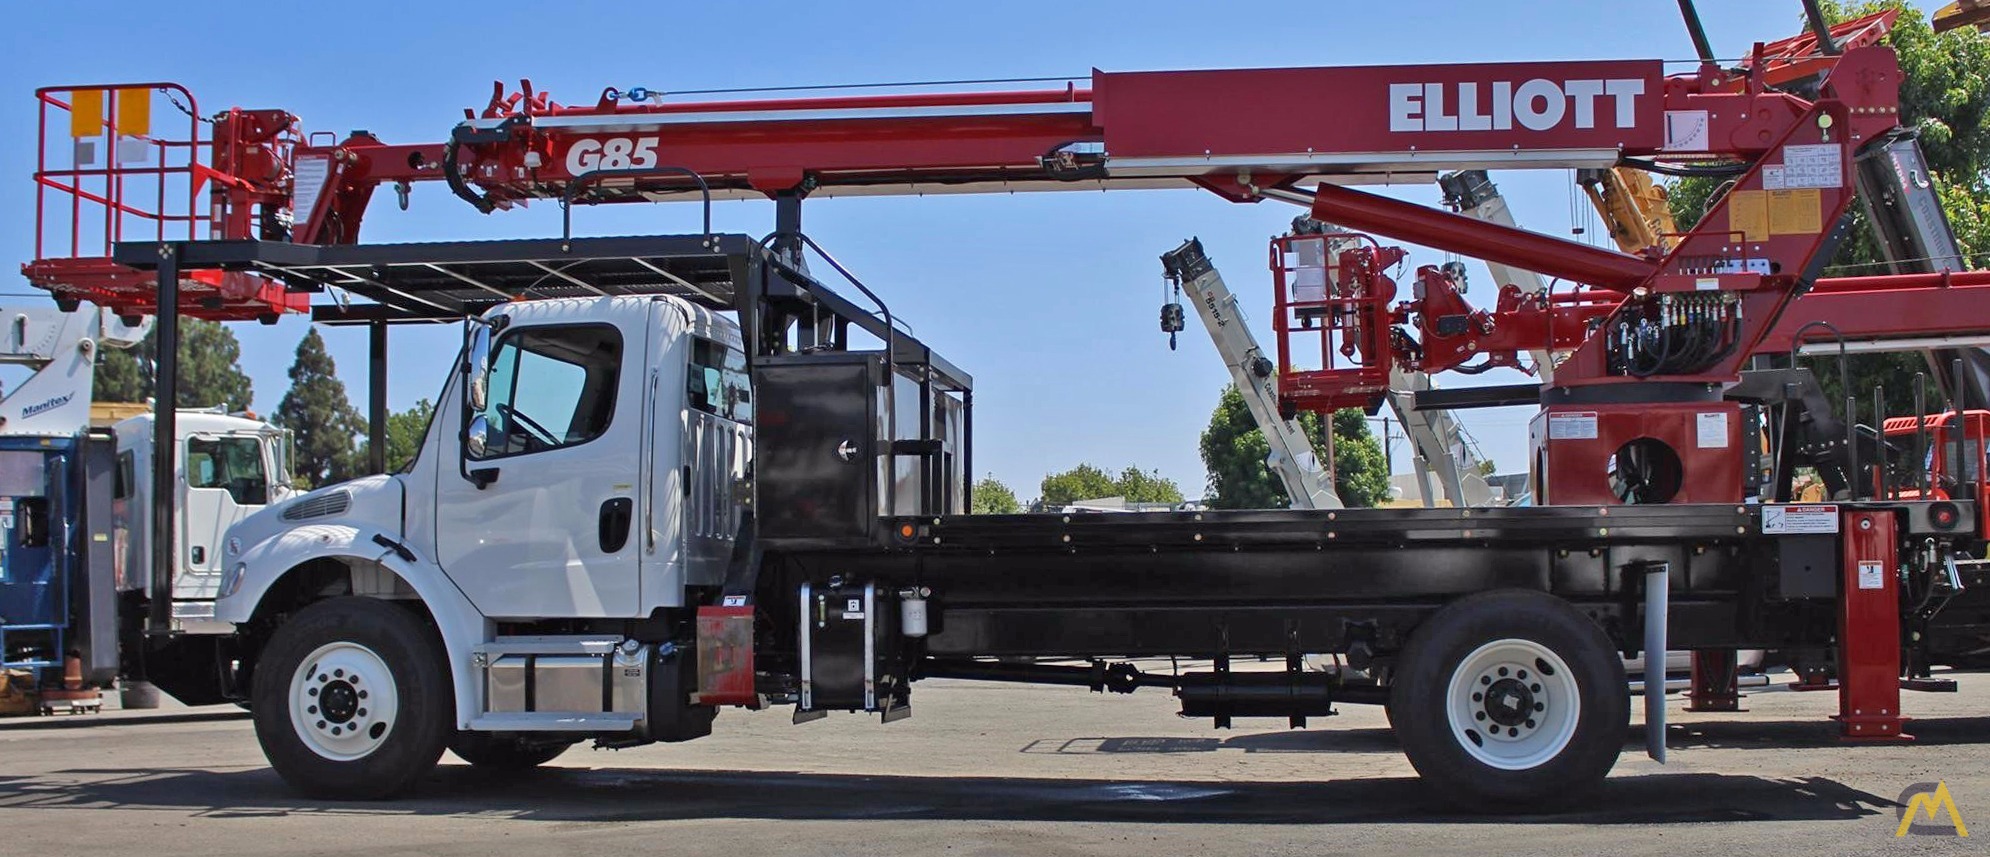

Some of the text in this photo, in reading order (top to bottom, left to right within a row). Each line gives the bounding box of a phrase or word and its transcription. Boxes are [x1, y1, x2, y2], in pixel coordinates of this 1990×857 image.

[1389, 78, 1645, 132] ELLIOTT
[566, 136, 659, 177] G85
[22, 393, 73, 418] Manitex
